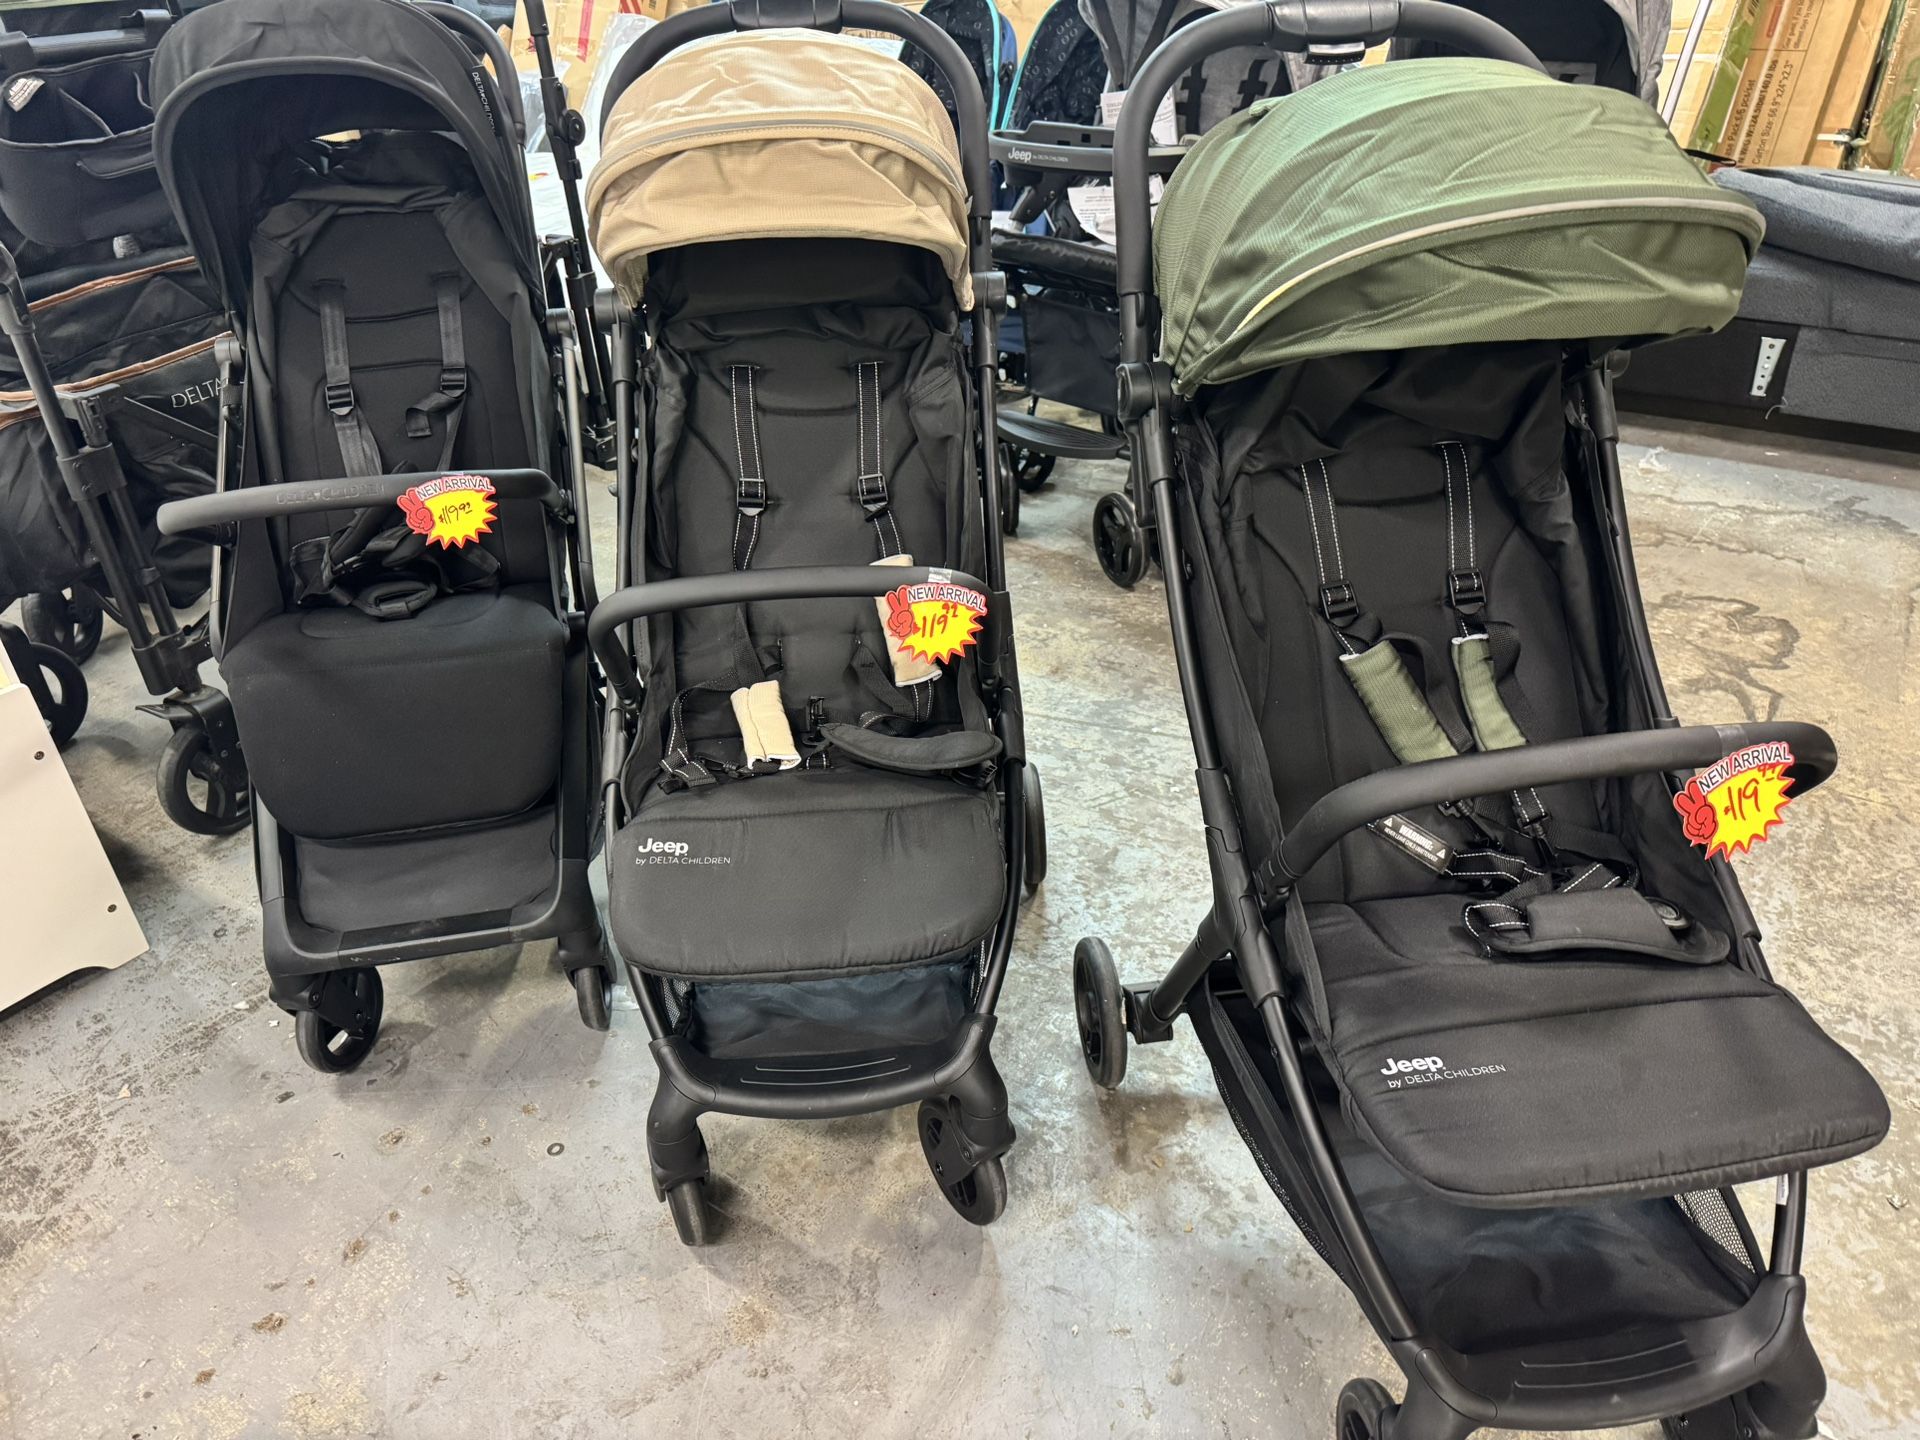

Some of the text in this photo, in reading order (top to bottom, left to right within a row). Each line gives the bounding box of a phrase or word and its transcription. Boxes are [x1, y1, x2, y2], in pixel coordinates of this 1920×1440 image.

[1767, 59, 1779, 73] lbs
[471, 72, 485, 94] DELTA
[1007, 147, 1032, 163] Jeep
[1751, 139, 1767, 165] Carton
[171, 377, 222, 408] DELTA
[416, 477, 493, 499] NEW ARRIVAL
[908, 586, 985, 611] NEW ARRIVAL
[1698, 745, 1791, 793] NEW ARRIVAL
[638, 838, 689, 856] Jeep
[1398, 824, 1434, 851] WARNING:
[635, 856, 731, 867] by DELTA CHILDREN
[1380, 1056, 1446, 1076] Jeep
[1387, 1064, 1507, 1089] by DELTA CHILDREN
